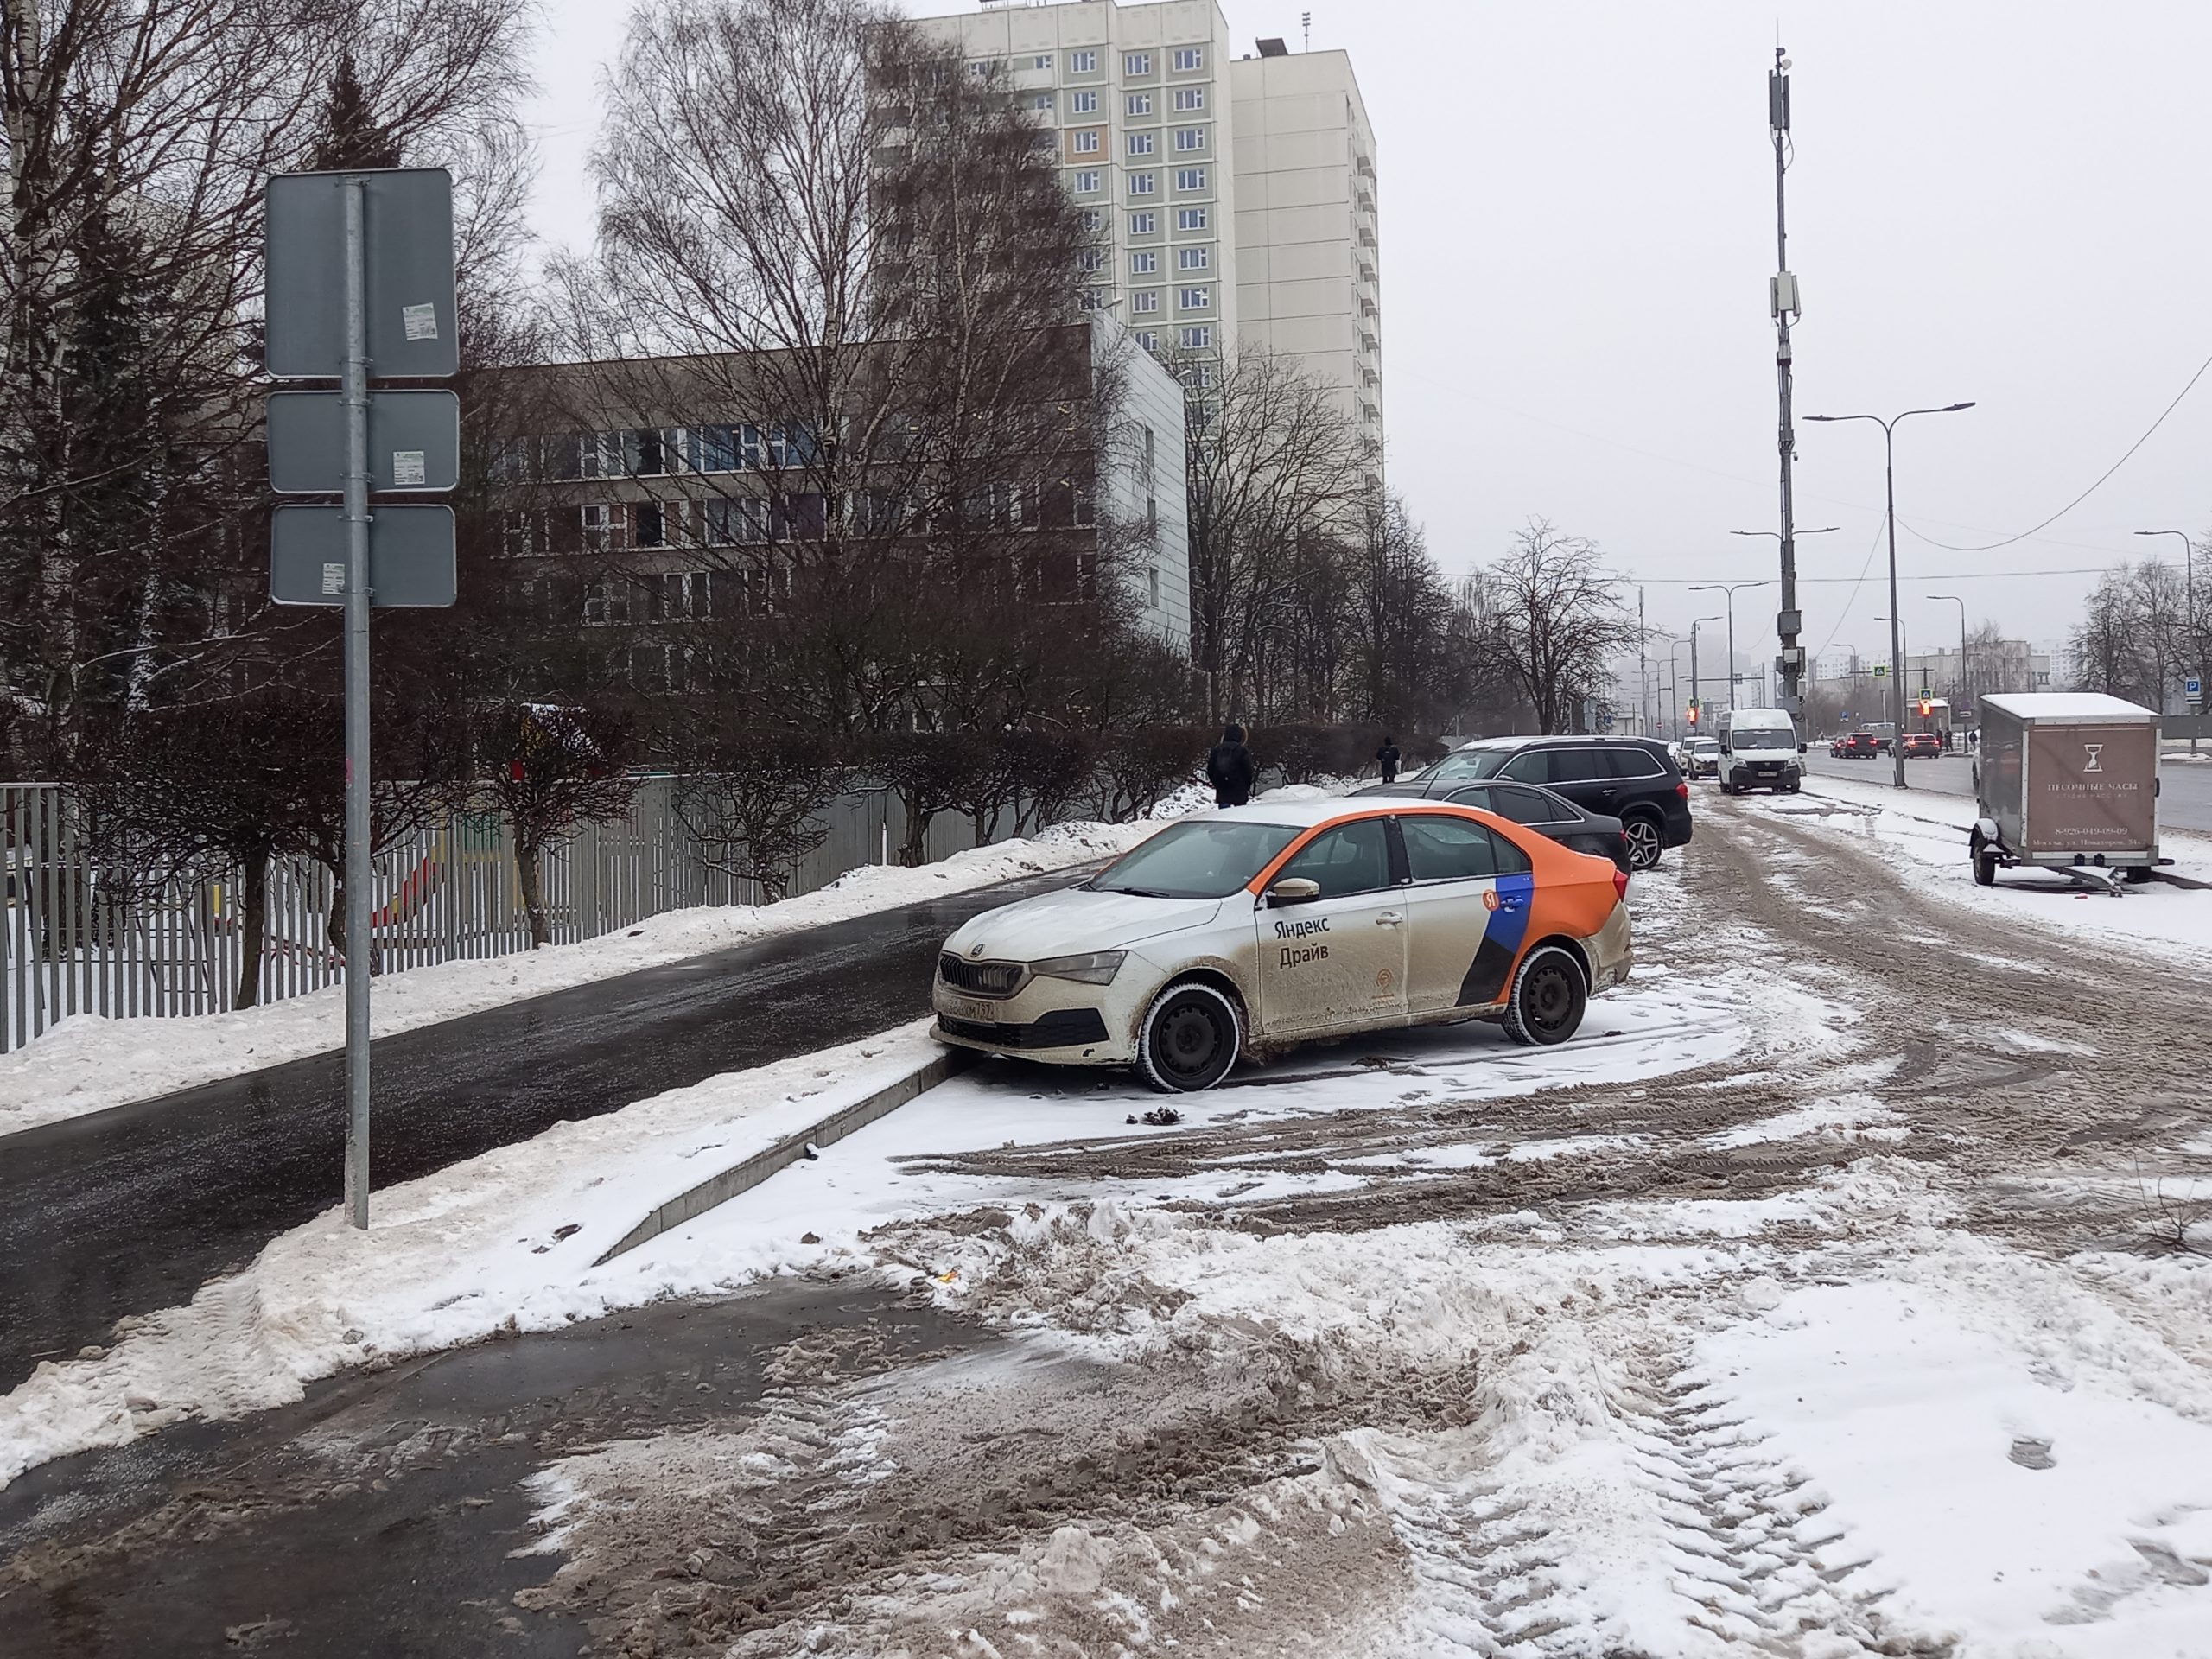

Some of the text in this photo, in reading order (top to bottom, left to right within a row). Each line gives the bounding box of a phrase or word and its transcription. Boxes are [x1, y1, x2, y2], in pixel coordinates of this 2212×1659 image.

[2189, 682, 2196, 691] P
[2047, 783, 2104, 791] ПЕСОЧНЫЕ
[1486, 893, 1496, 907] Я
[1274, 918, 1330, 939] Яндекс
[1280, 942, 1329, 969] Драйв
